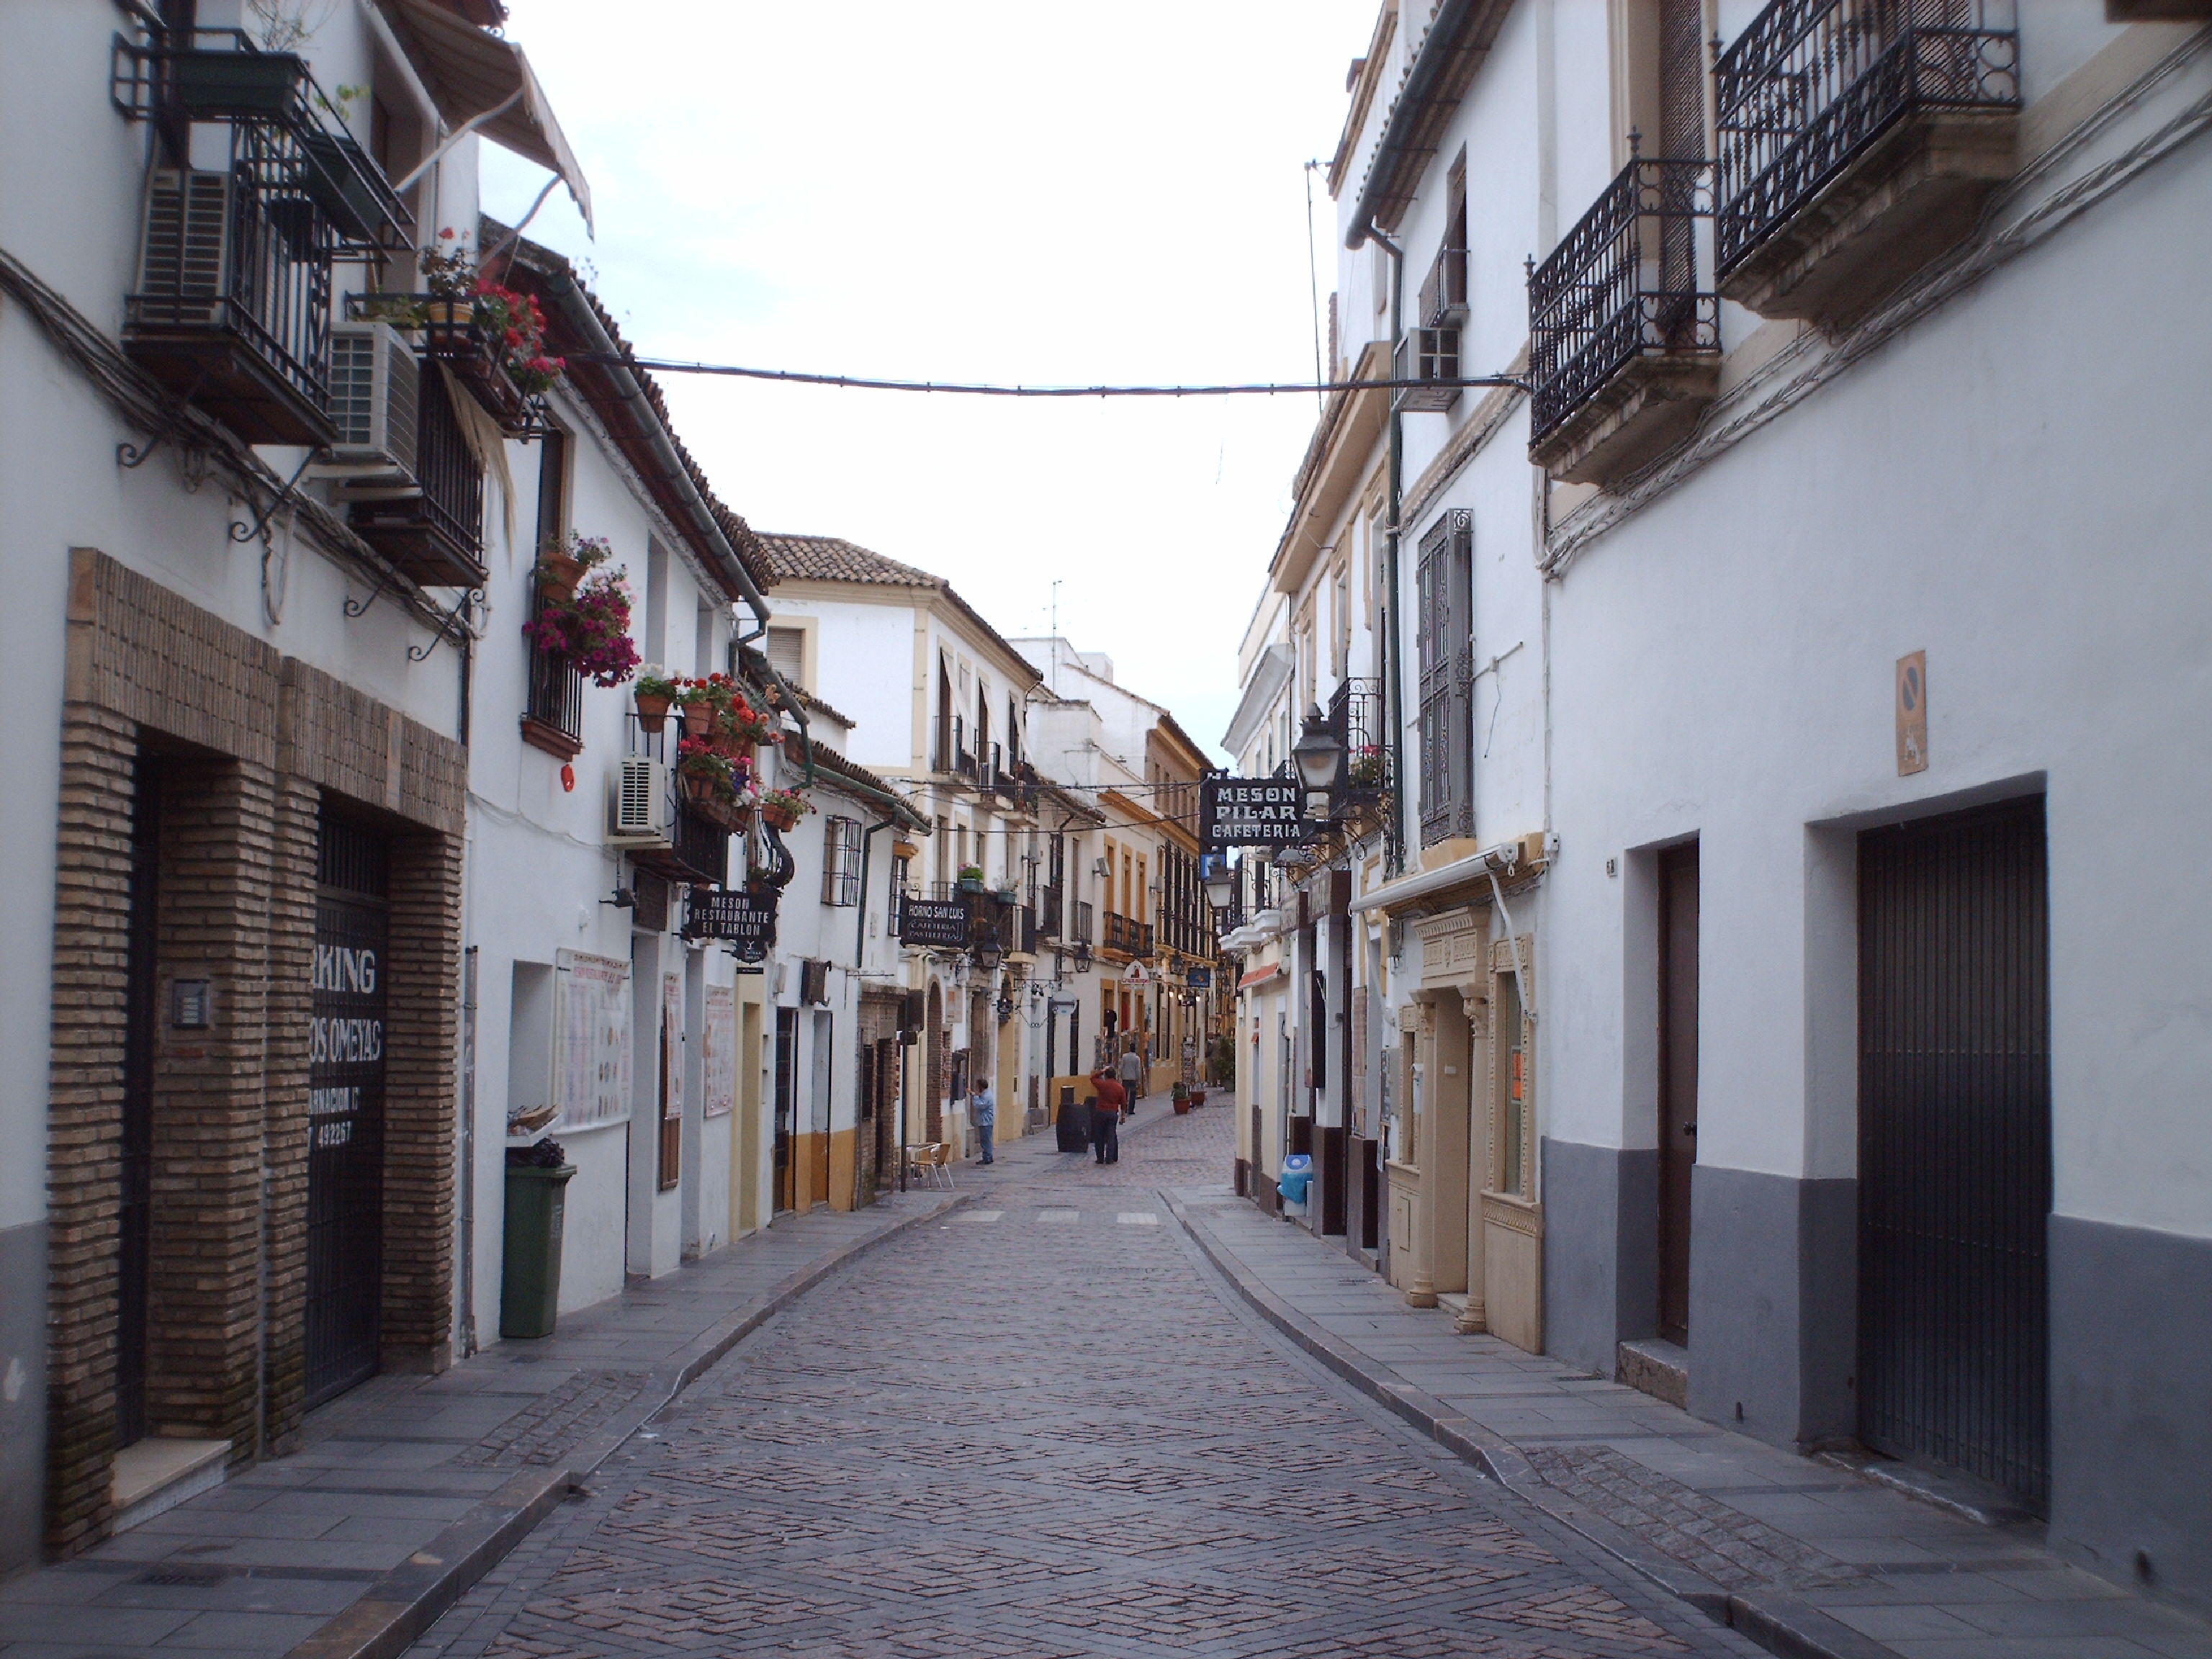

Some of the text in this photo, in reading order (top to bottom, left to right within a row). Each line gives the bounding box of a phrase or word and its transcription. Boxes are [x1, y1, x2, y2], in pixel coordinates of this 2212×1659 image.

[1217, 787, 1296, 803] MESON
[1215, 805, 1298, 820] PILAR
[1212, 824, 1300, 838] CAFETERIA
[711, 896, 750, 909] MESON
[694, 909, 769, 923] RESTAURANTE
[909, 905, 964, 920] HORNO SAN LUIS
[703, 922, 713, 933] EL
[721, 922, 760, 935] TABLON
[330, 1017, 381, 1063] OMEYAS
